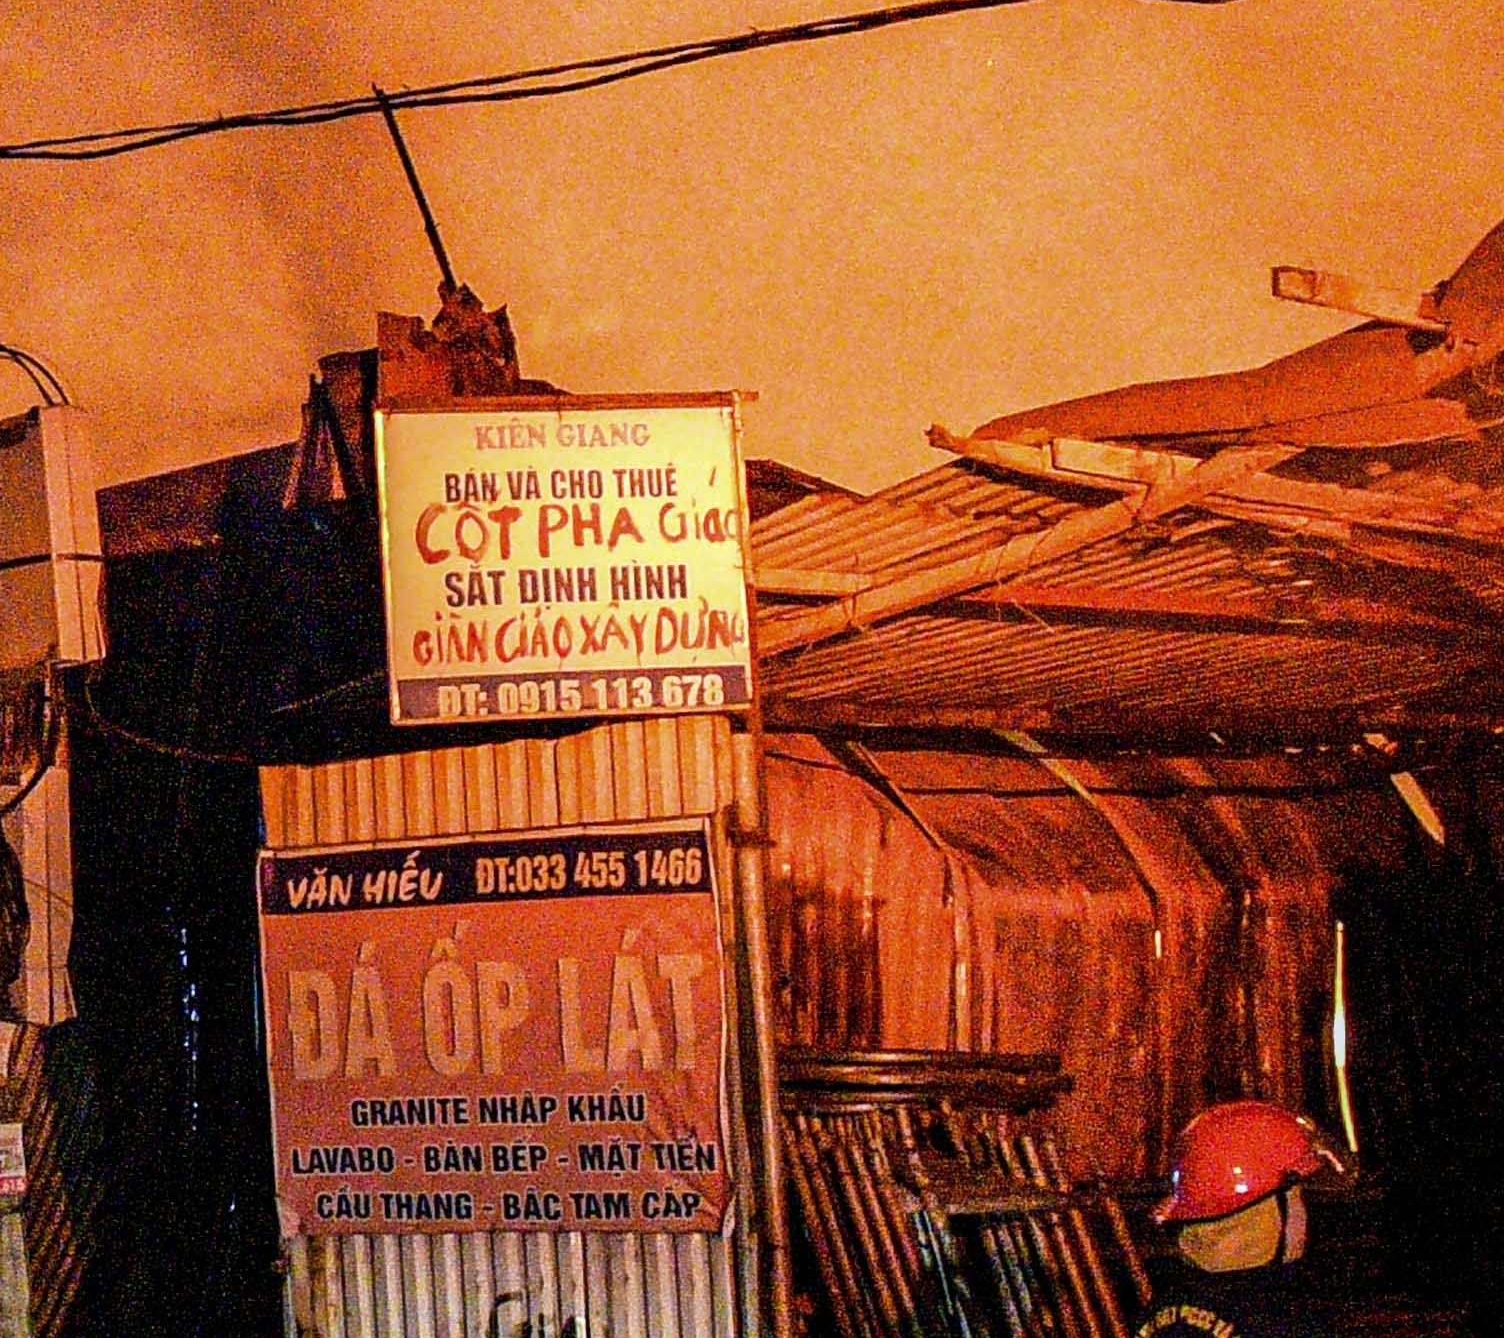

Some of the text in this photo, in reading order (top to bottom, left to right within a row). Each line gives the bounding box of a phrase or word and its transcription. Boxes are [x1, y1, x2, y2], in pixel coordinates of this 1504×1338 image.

[474, 417, 651, 450] KIÊN GIANG
[444, 462, 677, 503] BÁN VÀ CHO THUÊ
[538, 502, 644, 558] PHA
[610, 560, 688, 601] HÌNH
[579, 601, 648, 664] XÂY
[498, 678, 581, 714] 0915
[592, 676, 653, 711] 113
[662, 673, 725, 707] 678
[288, 867, 353, 909] VĂN
[363, 849, 443, 904] HIẾU
[573, 851, 626, 888] 455
[633, 847, 703, 887] 1466
[287, 919, 703, 1079] ĐÁ ỐP LÁT
[350, 1097, 469, 1127] GRANITE
[291, 1145, 395, 1175] LAVABO
[424, 1139, 483, 1173] BÀN
[578, 1136, 641, 1178] MẶT
[379, 1191, 473, 1220] THANG
[569, 1191, 631, 1220] TAM
